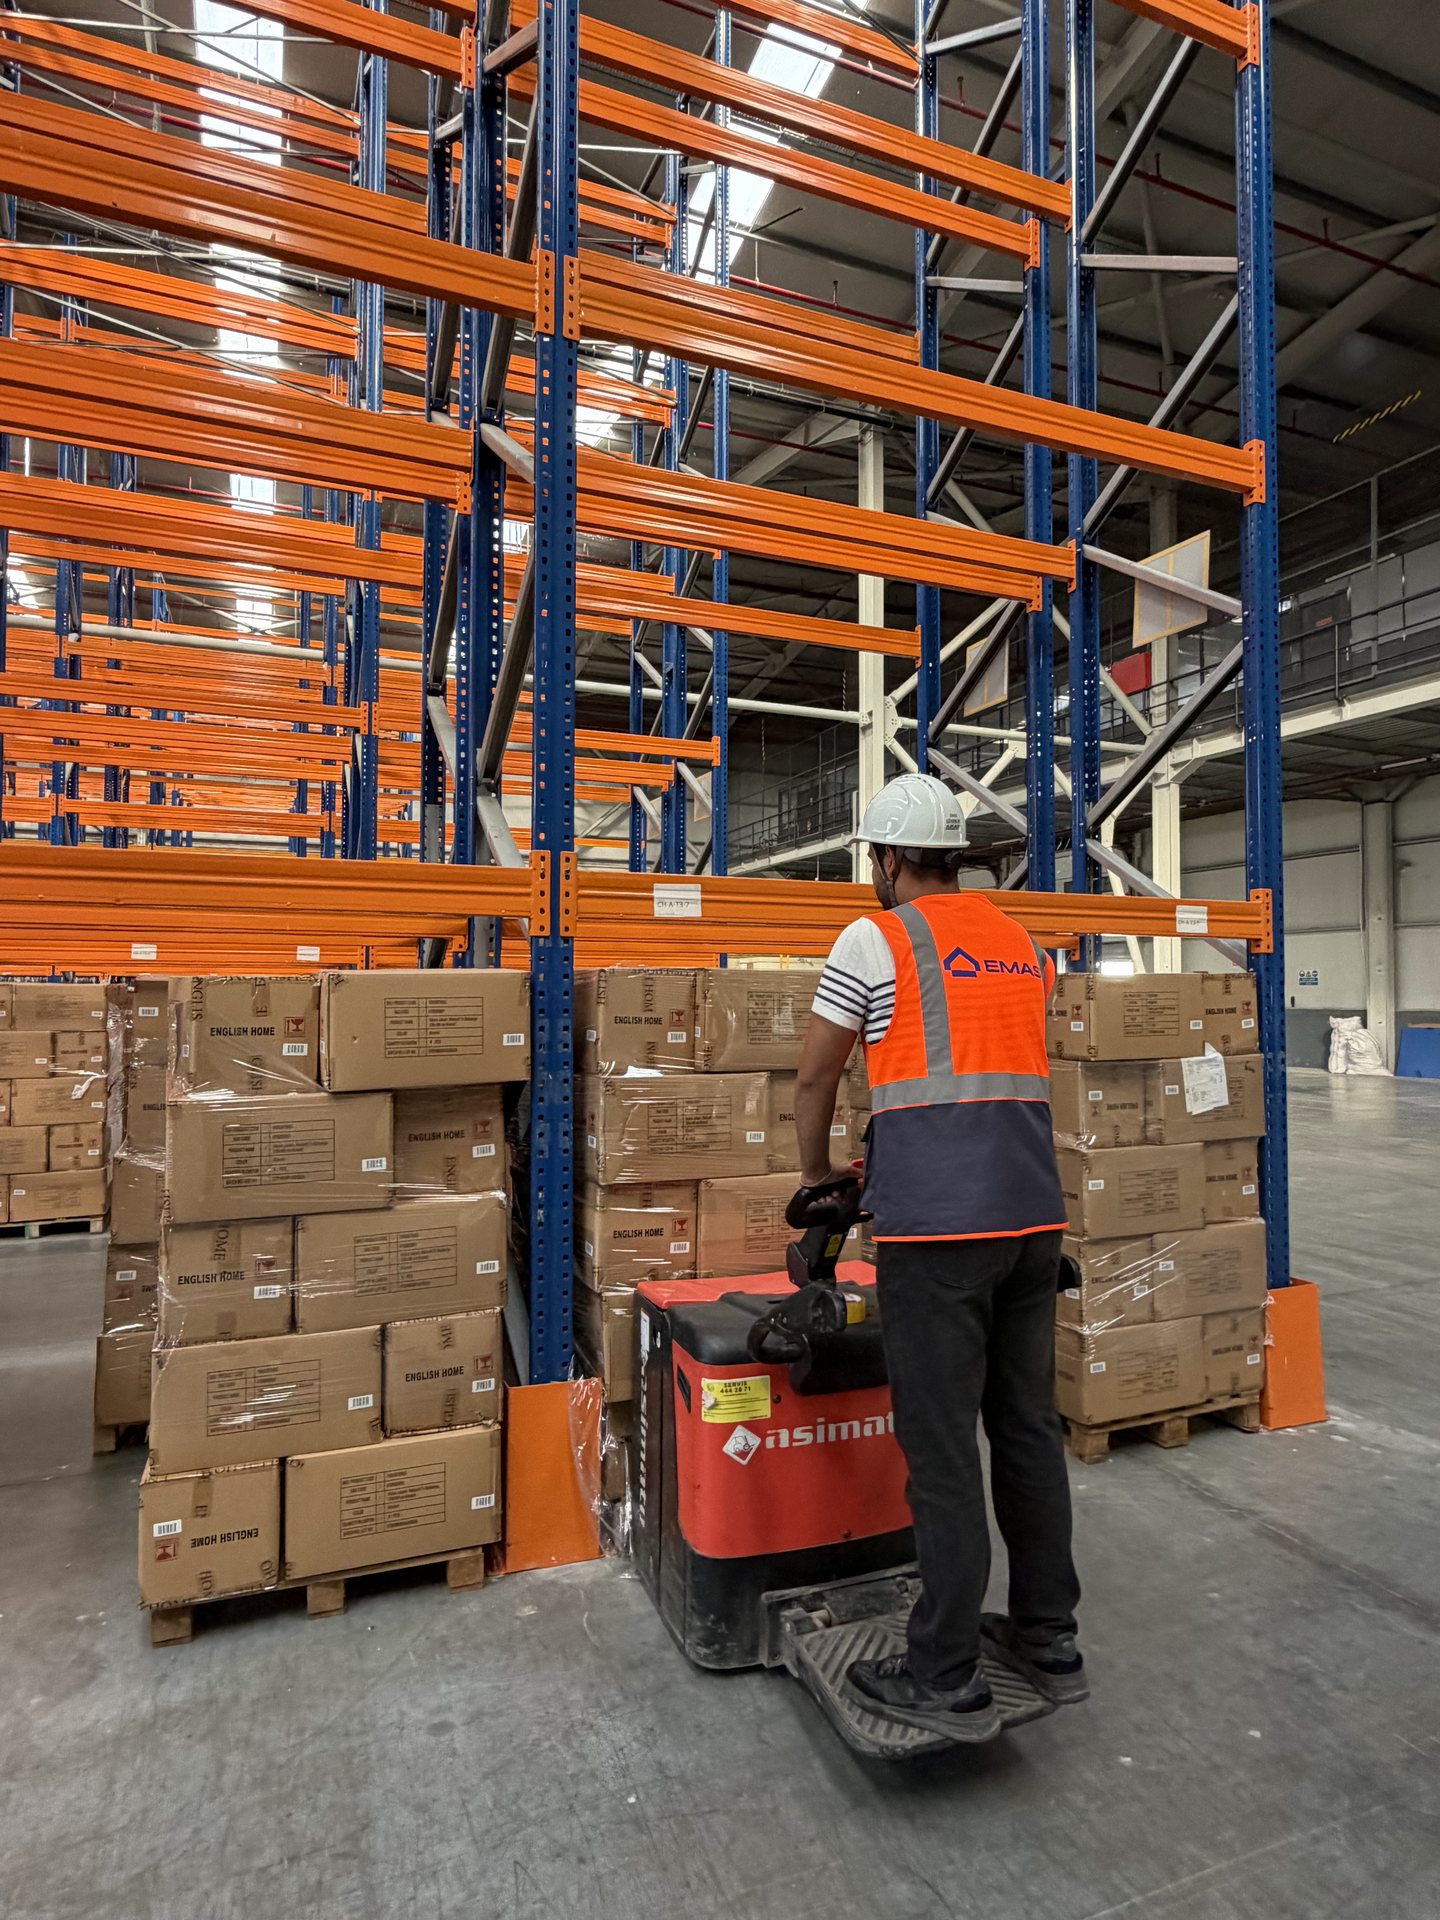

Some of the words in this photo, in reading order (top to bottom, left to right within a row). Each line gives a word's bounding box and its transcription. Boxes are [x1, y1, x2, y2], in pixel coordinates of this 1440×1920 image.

[983, 959, 1041, 978] EMAS
[614, 1015, 643, 1025] ENGLISH
[644, 1016, 663, 1025] HOME
[209, 1026, 249, 1037] ENGLISH
[250, 1026, 276, 1036] HOME
[408, 1131, 442, 1142] ENGLISH
[443, 1129, 465, 1139] HOME
[613, 1228, 643, 1239] ENGLISH
[644, 1227, 665, 1237] HOME
[177, 1273, 217, 1285] ENGLISH
[219, 1271, 246, 1282] HOME
[405, 1370, 440, 1382] ENGLISH
[441, 1365, 464, 1377] HOME
[190, 1535, 217, 1548] HOME
[220, 1528, 259, 1543] ENGLISH
